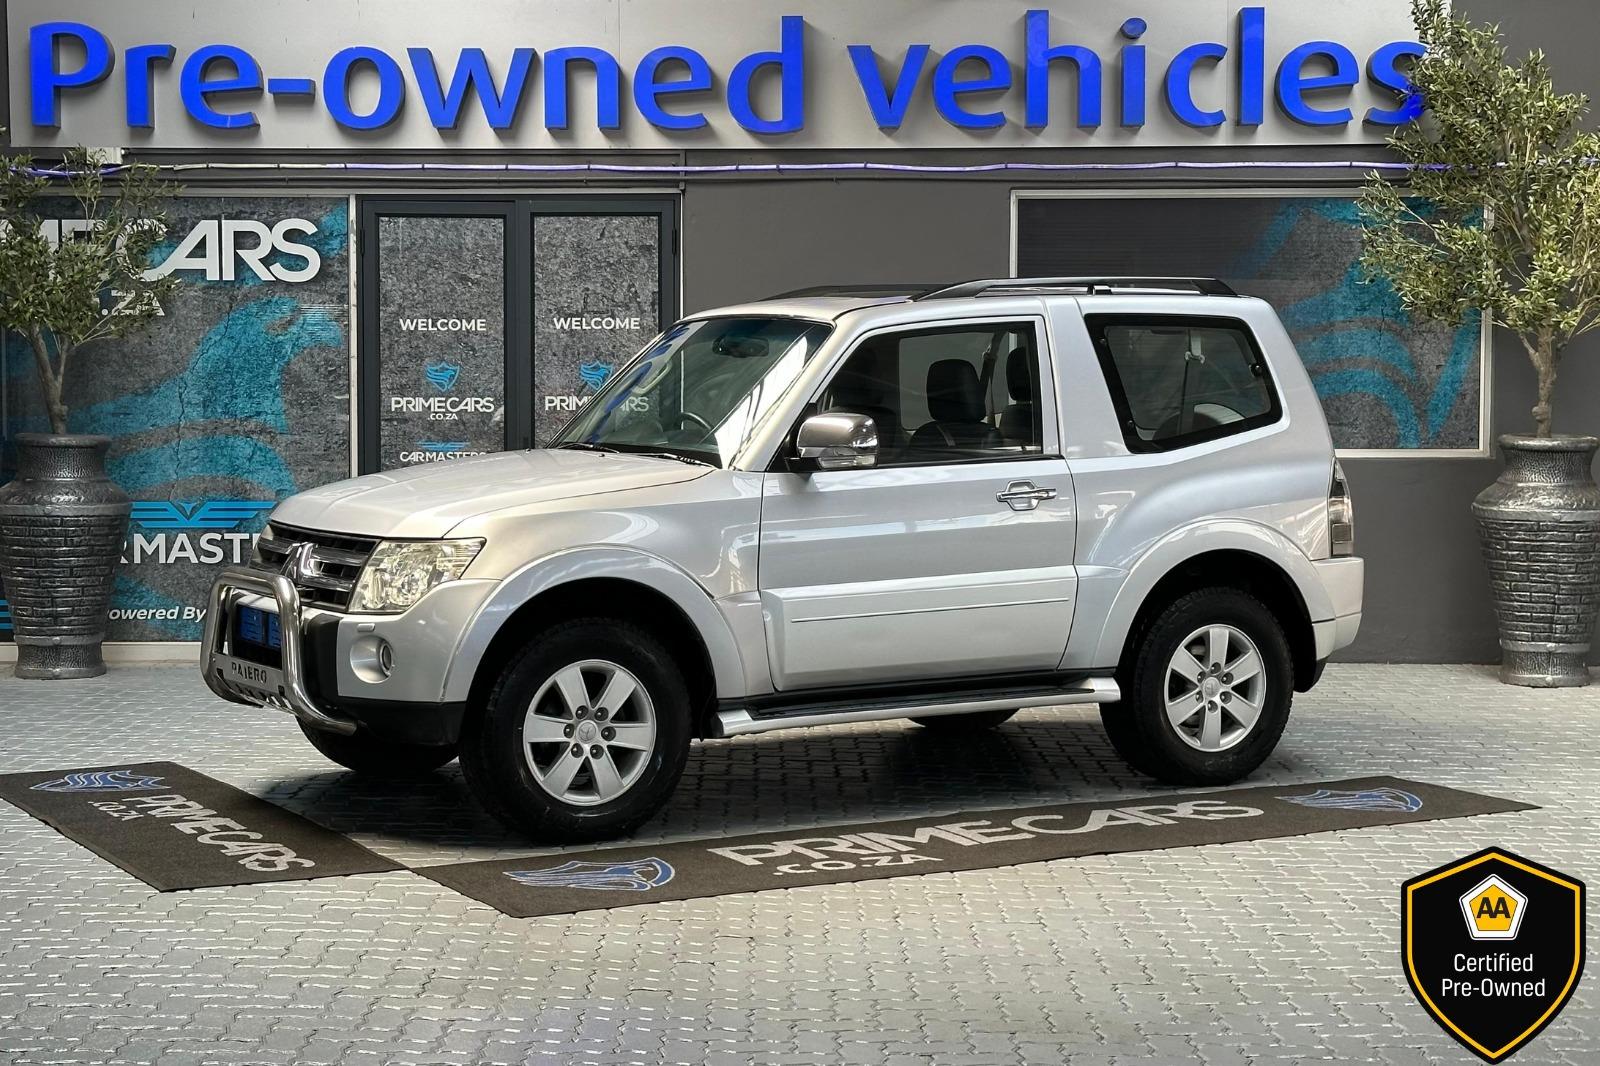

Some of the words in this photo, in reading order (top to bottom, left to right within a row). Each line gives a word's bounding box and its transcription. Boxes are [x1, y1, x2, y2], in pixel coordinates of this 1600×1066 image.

[29, 15, 804, 134] Pre-owned
[847, 7, 1426, 130] vehicles
[0, 217, 321, 282] CARS
[399, 318, 487, 331] WELCOME
[553, 317, 641, 330] WELCOME
[391, 397, 495, 412] PRIMECARS
[119, 533, 262, 564] MAST
[107, 606, 179, 620] owered
[182, 606, 207, 623] By
[121, 794, 316, 872] PRIMECARS
[706, 800, 1265, 866] PRIMECARS
[773, 853, 944, 876] .CO.ZA
